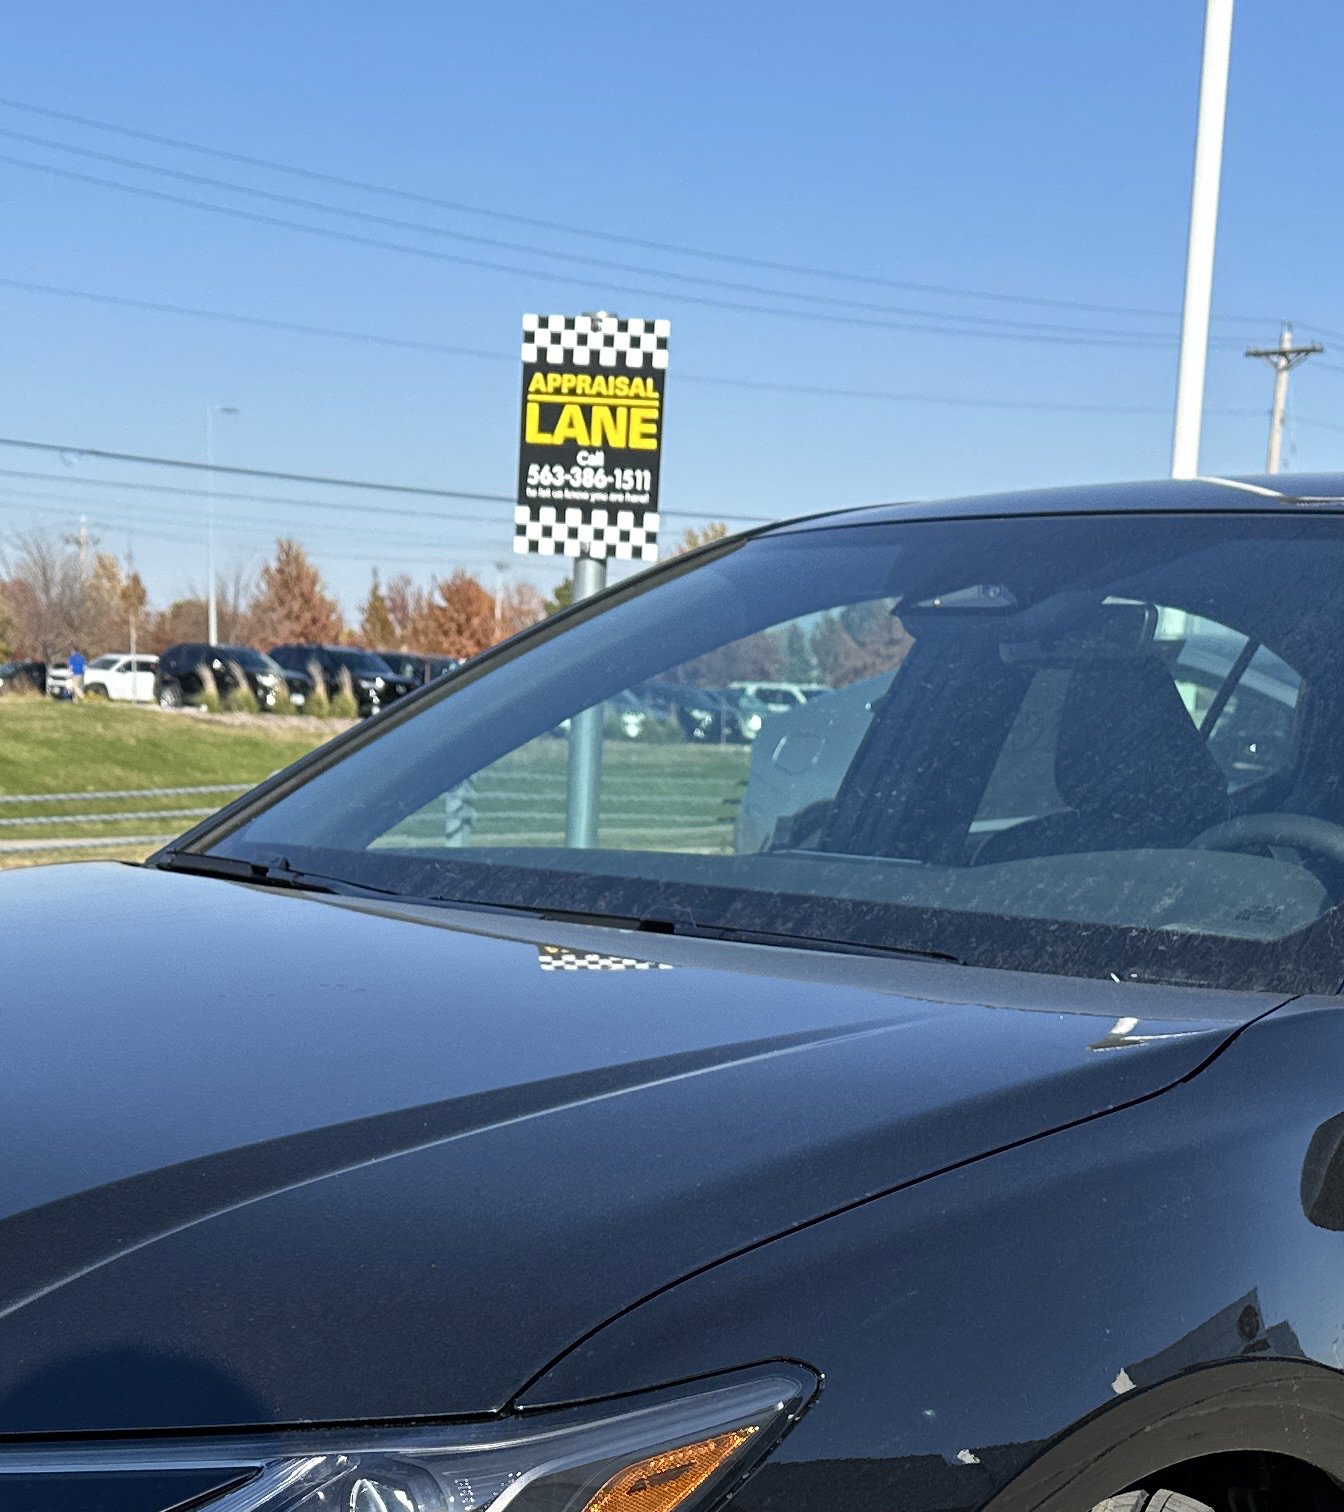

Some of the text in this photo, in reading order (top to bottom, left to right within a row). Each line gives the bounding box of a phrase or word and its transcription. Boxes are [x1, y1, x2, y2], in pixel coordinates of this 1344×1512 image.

[528, 372, 659, 398] APPRAISAL
[525, 402, 658, 450] LANE
[577, 450, 604, 466] Call
[527, 463, 651, 491] 563-386-1511
[590, 492, 608, 503] you
